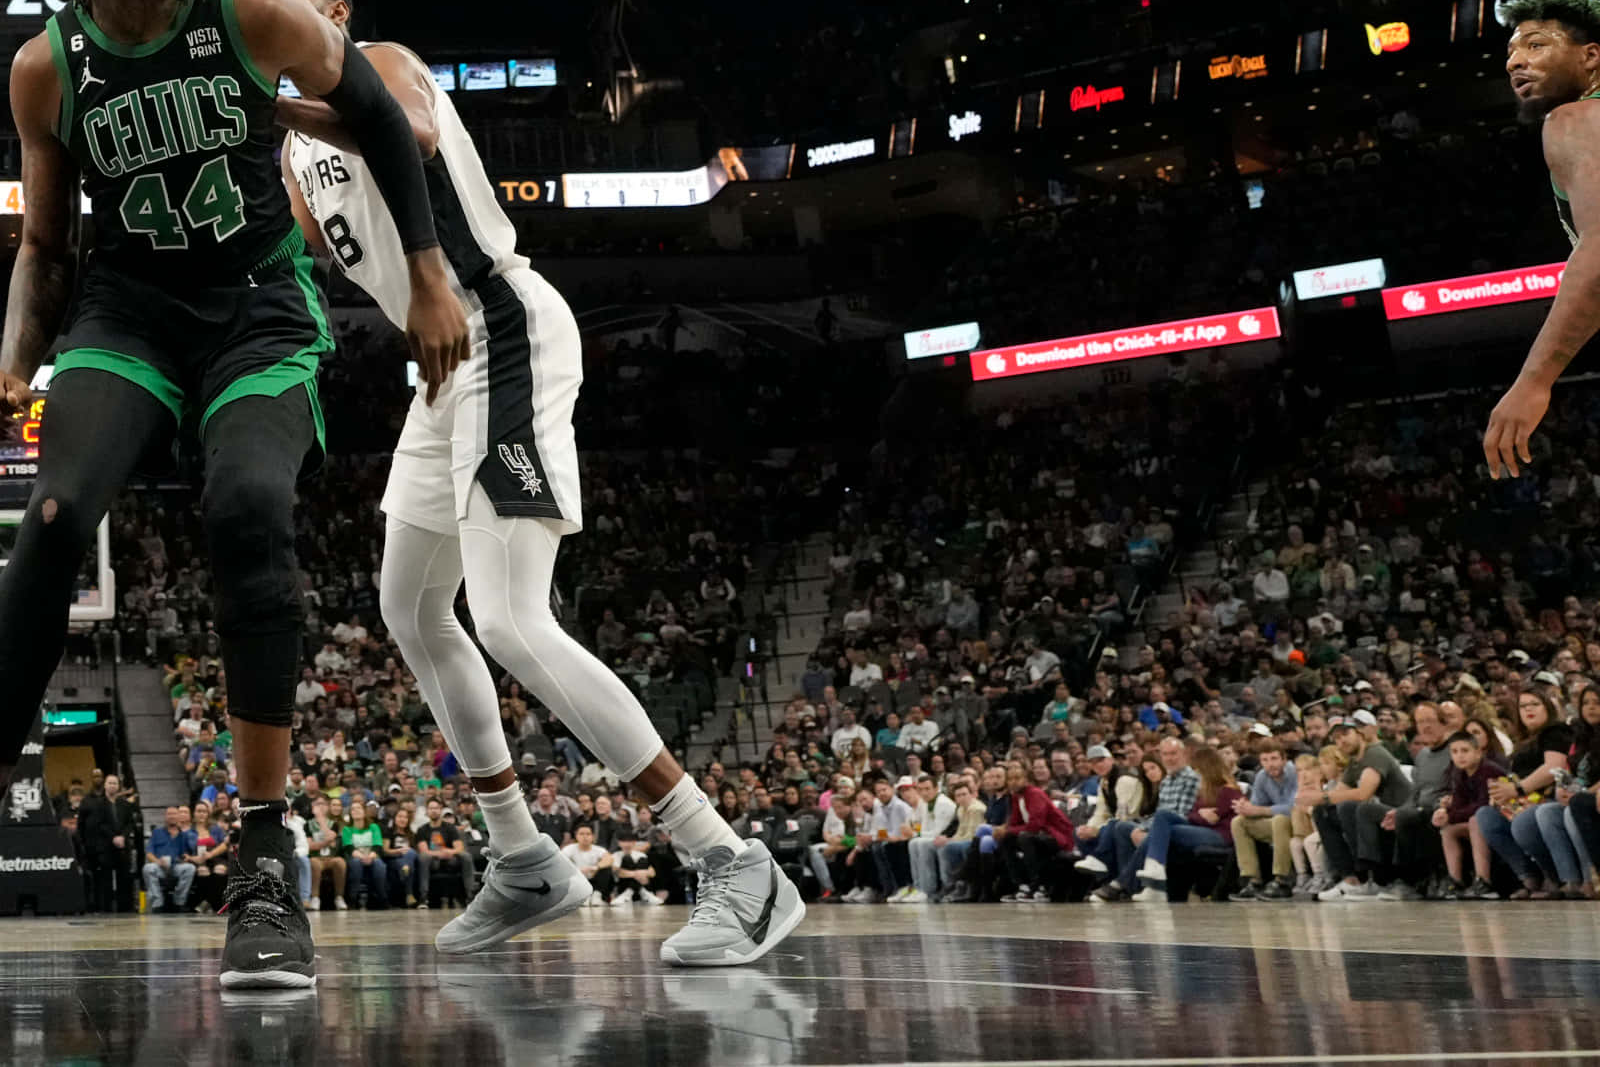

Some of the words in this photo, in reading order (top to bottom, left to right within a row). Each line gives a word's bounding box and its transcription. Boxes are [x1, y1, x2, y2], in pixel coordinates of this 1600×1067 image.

[70, 34, 84, 52] 6
[186, 27, 219, 46] VISTA
[190, 43, 223, 59] PRINT
[83, 75, 247, 177] CELTICS
[119, 154, 247, 250] 44
[499, 181, 540, 202] TO
[324, 213, 364, 273] 8
[1437, 279, 1523, 304] Download
[1525, 273, 1555, 290] the
[1015, 346, 1085, 367] Download
[1087, 340, 1112, 357] the
[1196, 323, 1227, 342] App
[21, 742, 44, 755] rite
[13, 788, 35, 805] 50
